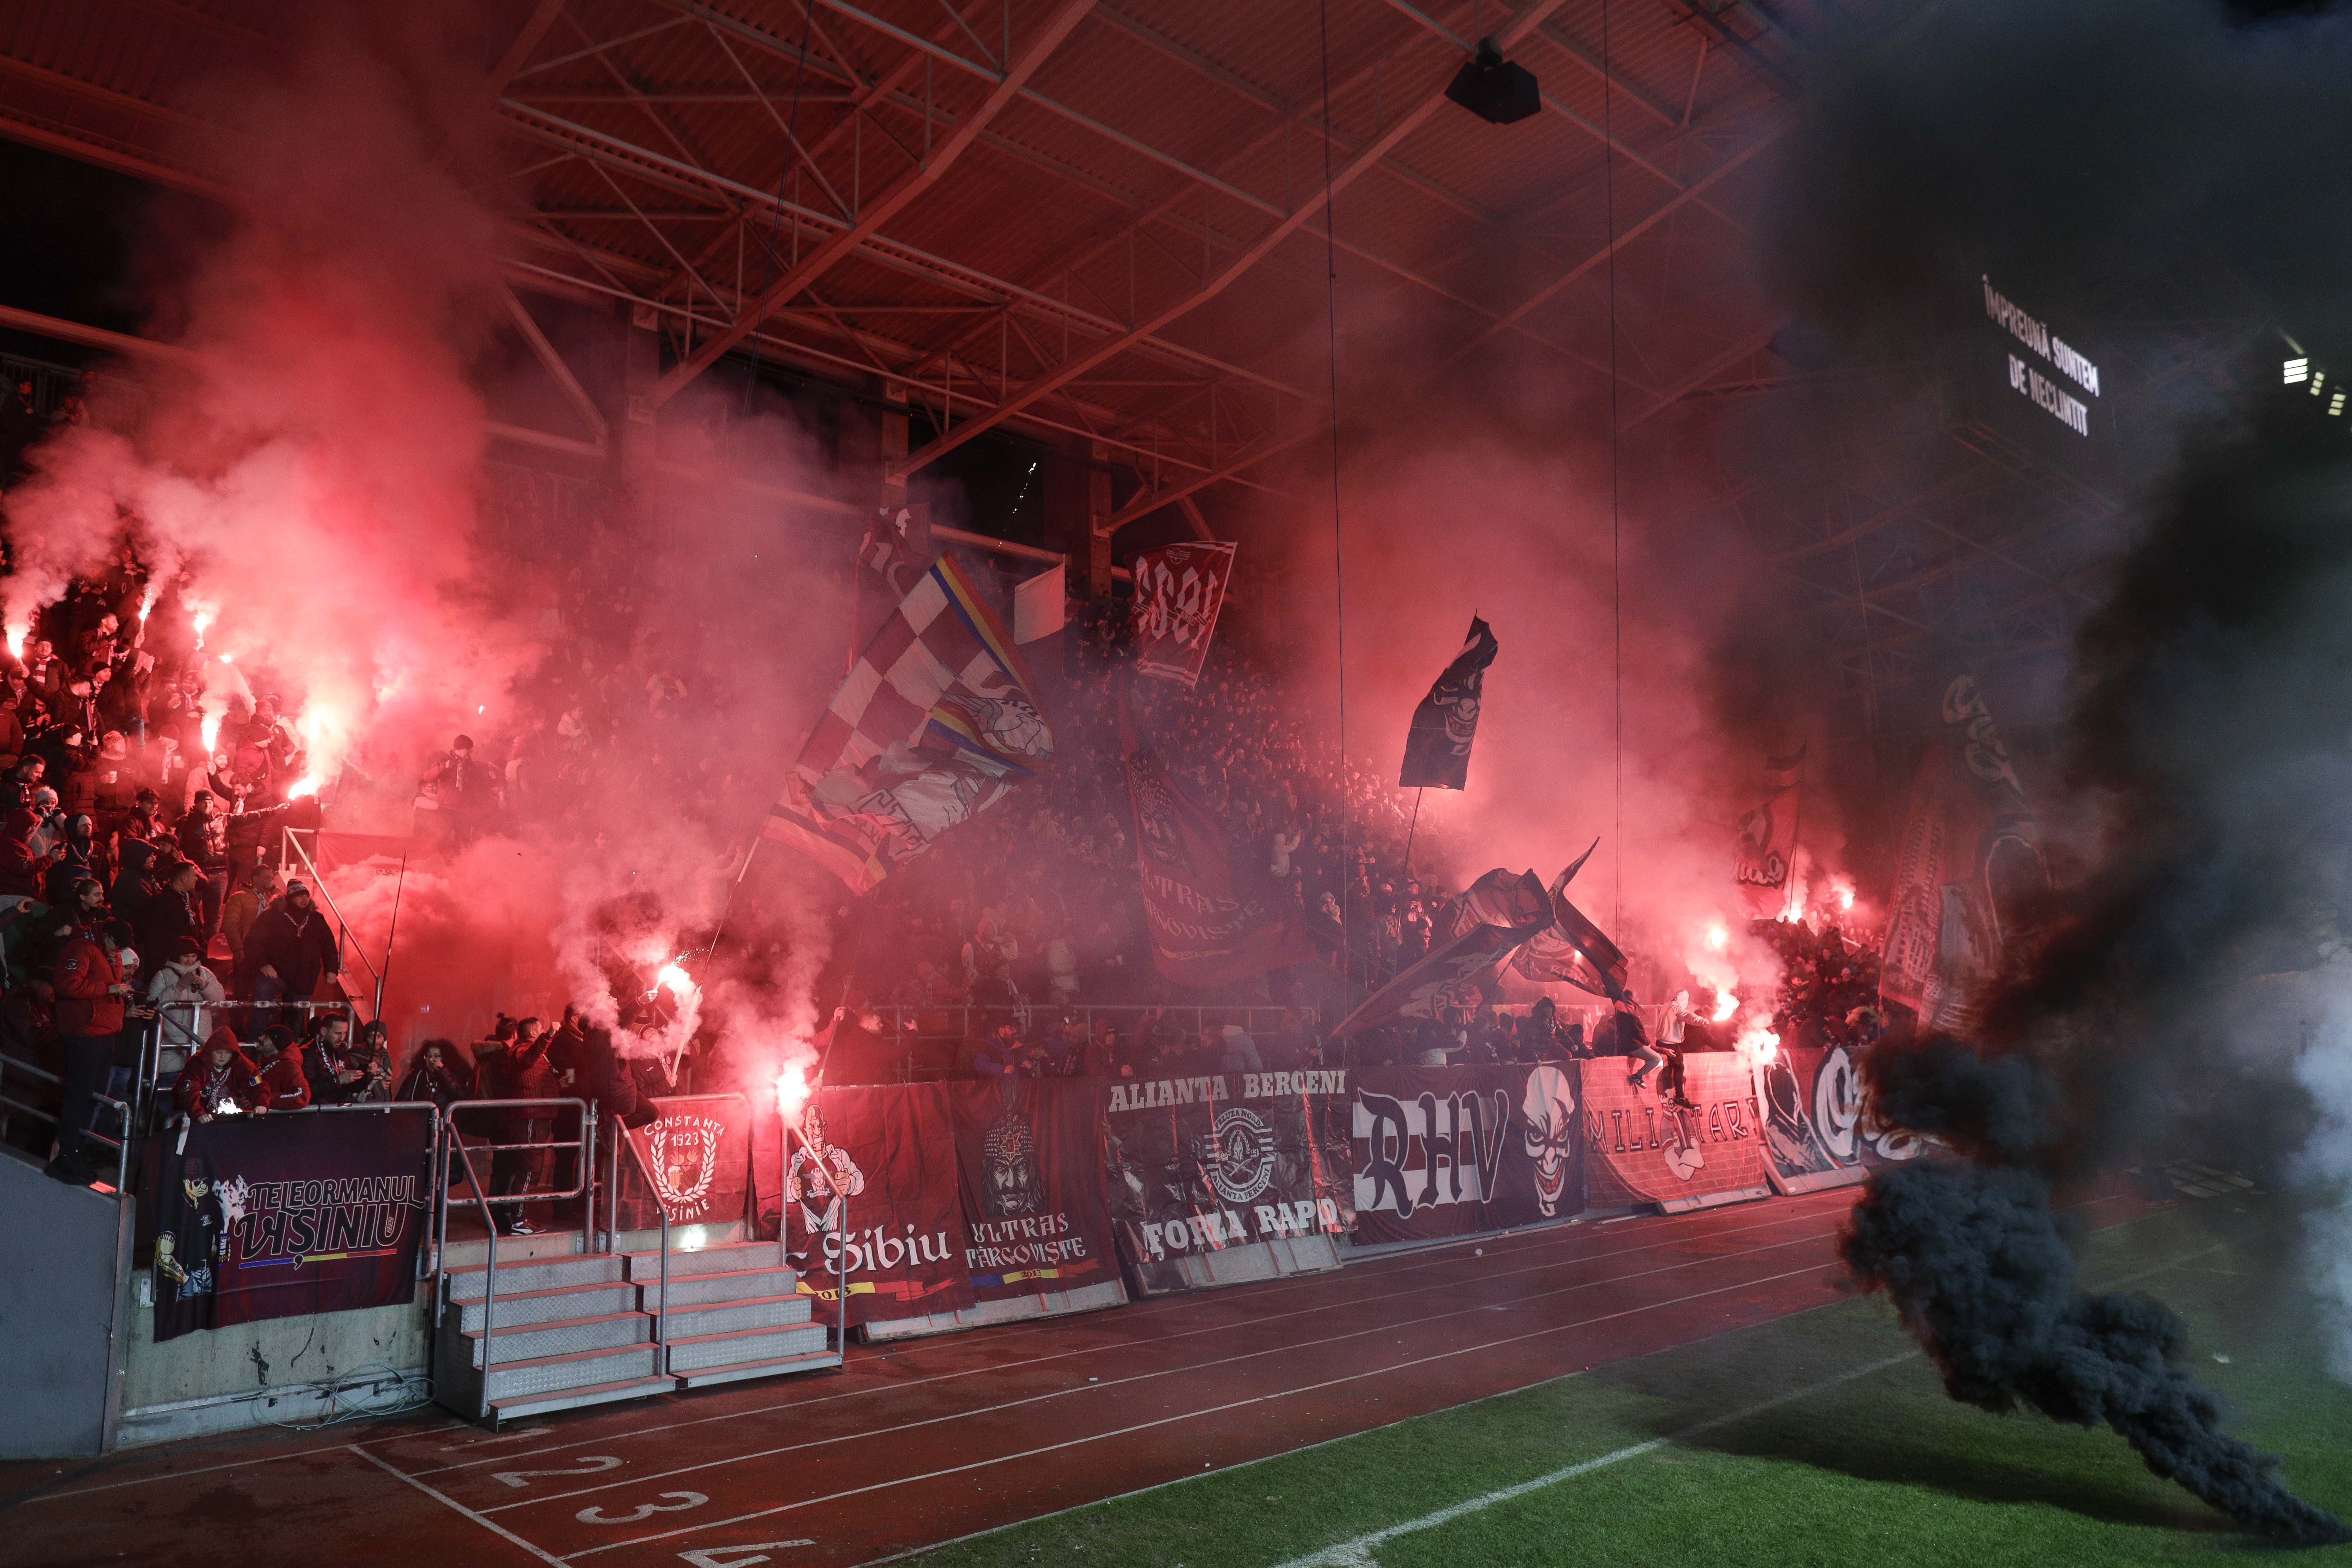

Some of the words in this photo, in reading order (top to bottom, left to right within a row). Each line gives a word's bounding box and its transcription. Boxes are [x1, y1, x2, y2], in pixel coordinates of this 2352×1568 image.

[2052, 336, 2100, 397] SUNTEM
[2008, 354, 2028, 396] DE
[2029, 368, 2088, 437] NECLINTIT
[1109, 1076, 1229, 1112] ALIANTA
[1243, 1071, 1346, 1098] BERCENI
[1215, 1110, 1240, 1129] PELUZA
[1241, 1110, 1261, 1127] NORD
[671, 1132, 699, 1146] 1923
[1358, 1087, 1509, 1220] RHV
[248, 1176, 425, 1215] TELEORMANUL
[1212, 1176, 1243, 1200] ALIANTA
[1245, 1168, 1270, 1197] BERCENI
[972, 1213, 1068, 1242] ULTRAS
[1145, 1210, 1248, 1254] FORZA
[823, 1224, 952, 1275] Sibiu
[1022, 1269, 1041, 1278] 2013
[490, 1456, 623, 1487] 2
[575, 1491, 709, 1524] 3
